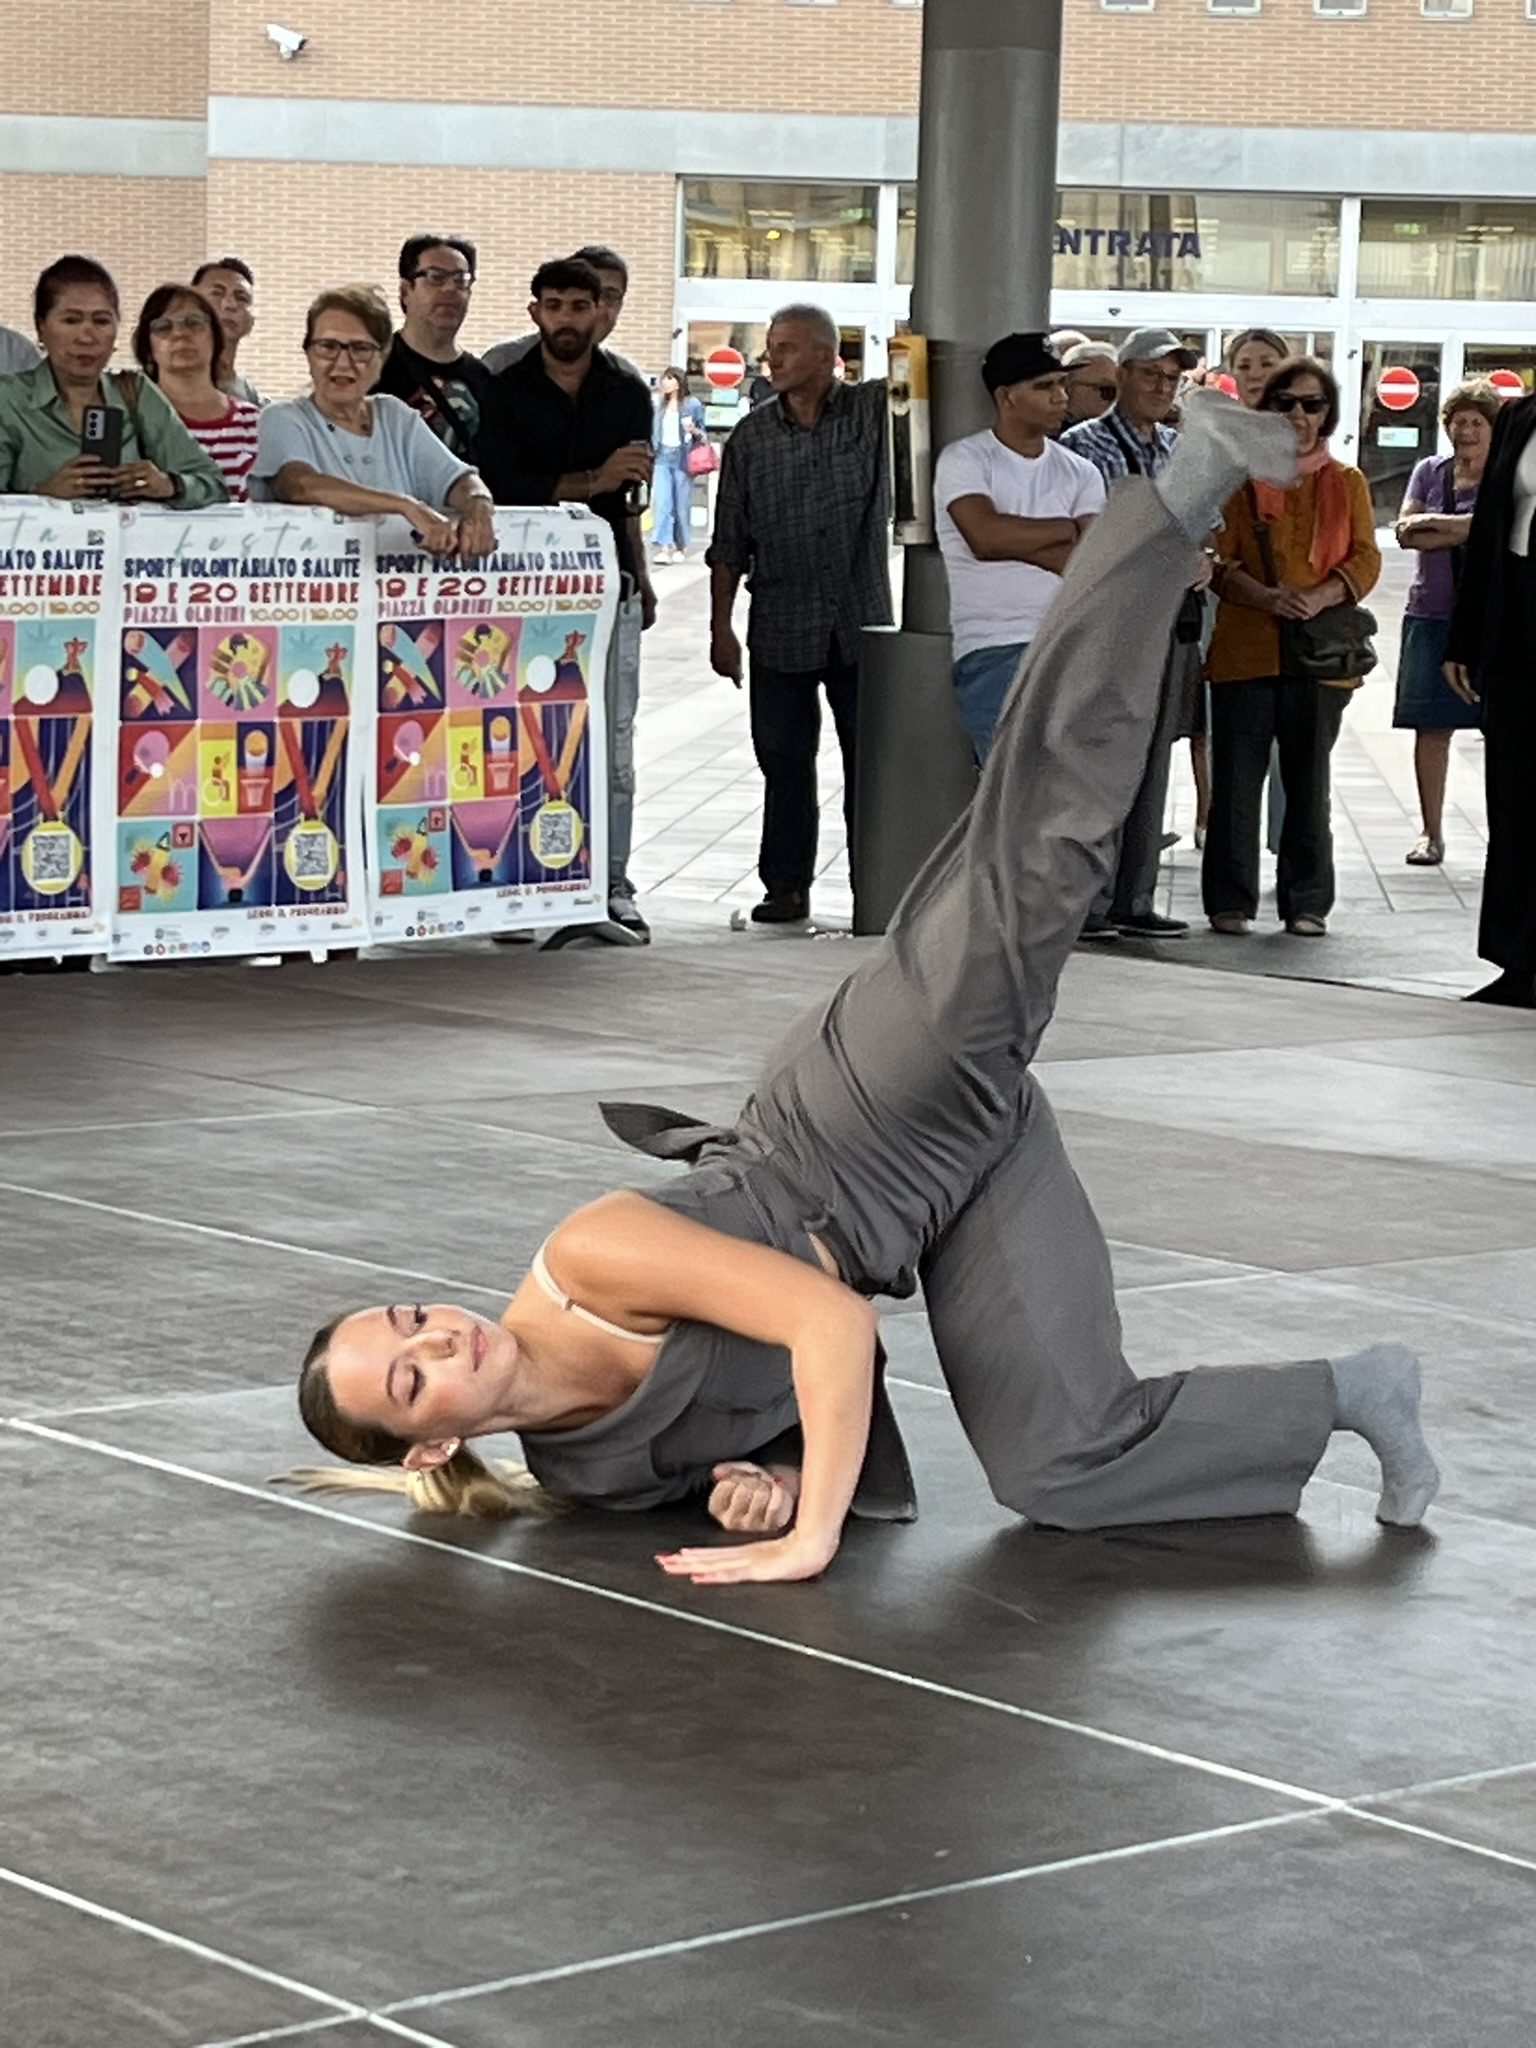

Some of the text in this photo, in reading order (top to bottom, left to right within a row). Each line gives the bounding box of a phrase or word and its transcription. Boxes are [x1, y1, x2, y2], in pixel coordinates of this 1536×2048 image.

[42, 549, 104, 570] SALUTE
[125, 558, 361, 578] SPORT VOLONTARIATO SALUTE
[550, 551, 604, 571] SALUTE
[0, 574, 102, 596] ETTEMBRE
[123, 582, 359, 604] 19 E 20 SETTEMBRE
[376, 575, 605, 599] 19 E 20 SETTEMBRE
[123, 606, 178, 623] PIAZZA
[377, 600, 426, 617] PIAZZA
